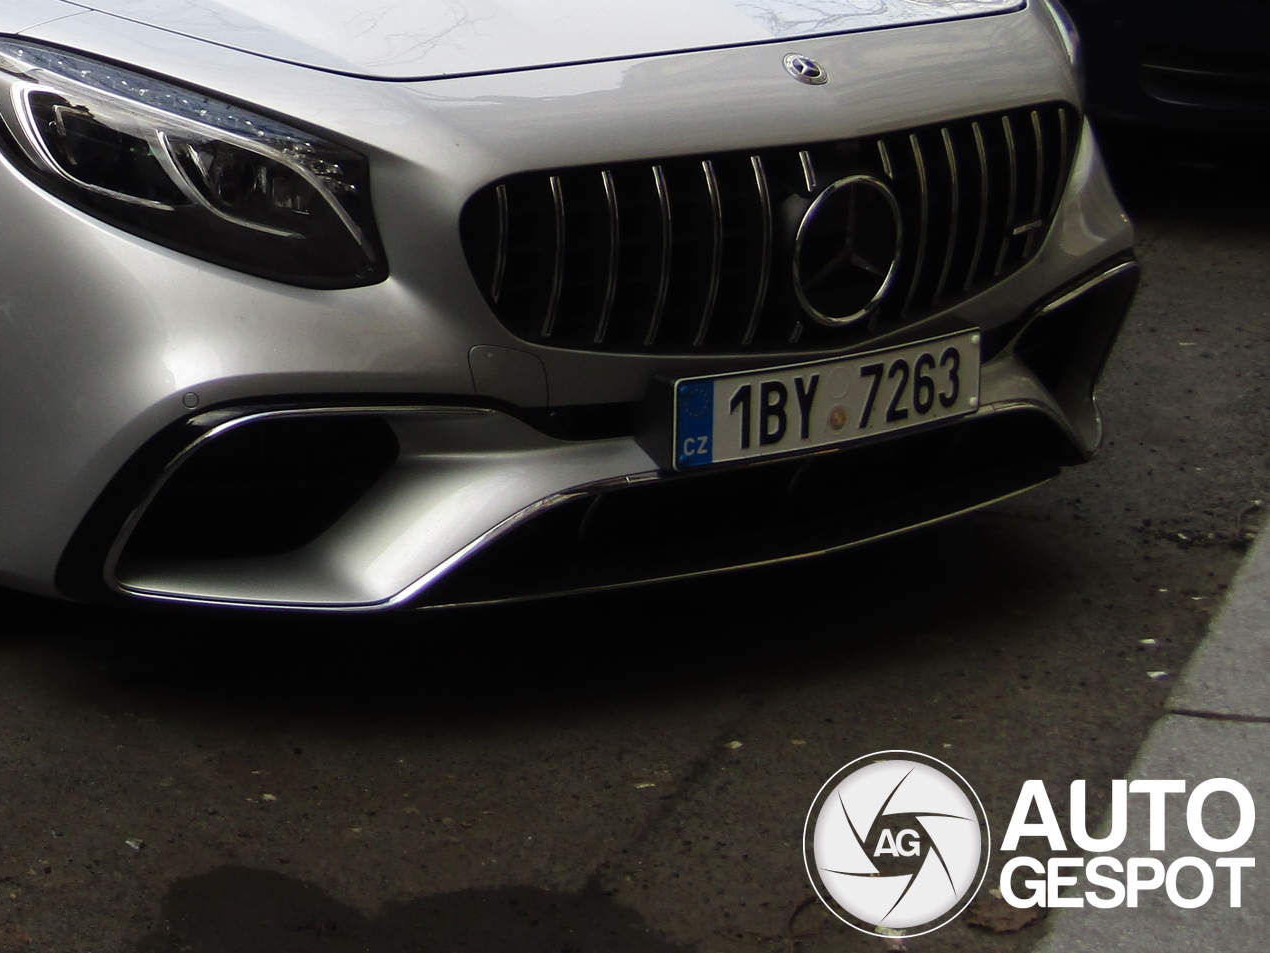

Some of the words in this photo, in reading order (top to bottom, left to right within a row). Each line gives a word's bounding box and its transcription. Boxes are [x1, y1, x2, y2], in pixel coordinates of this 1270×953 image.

[730, 373, 820, 450] 1BY
[858, 347, 961, 429] 7263
[683, 435, 708, 457] CZ
